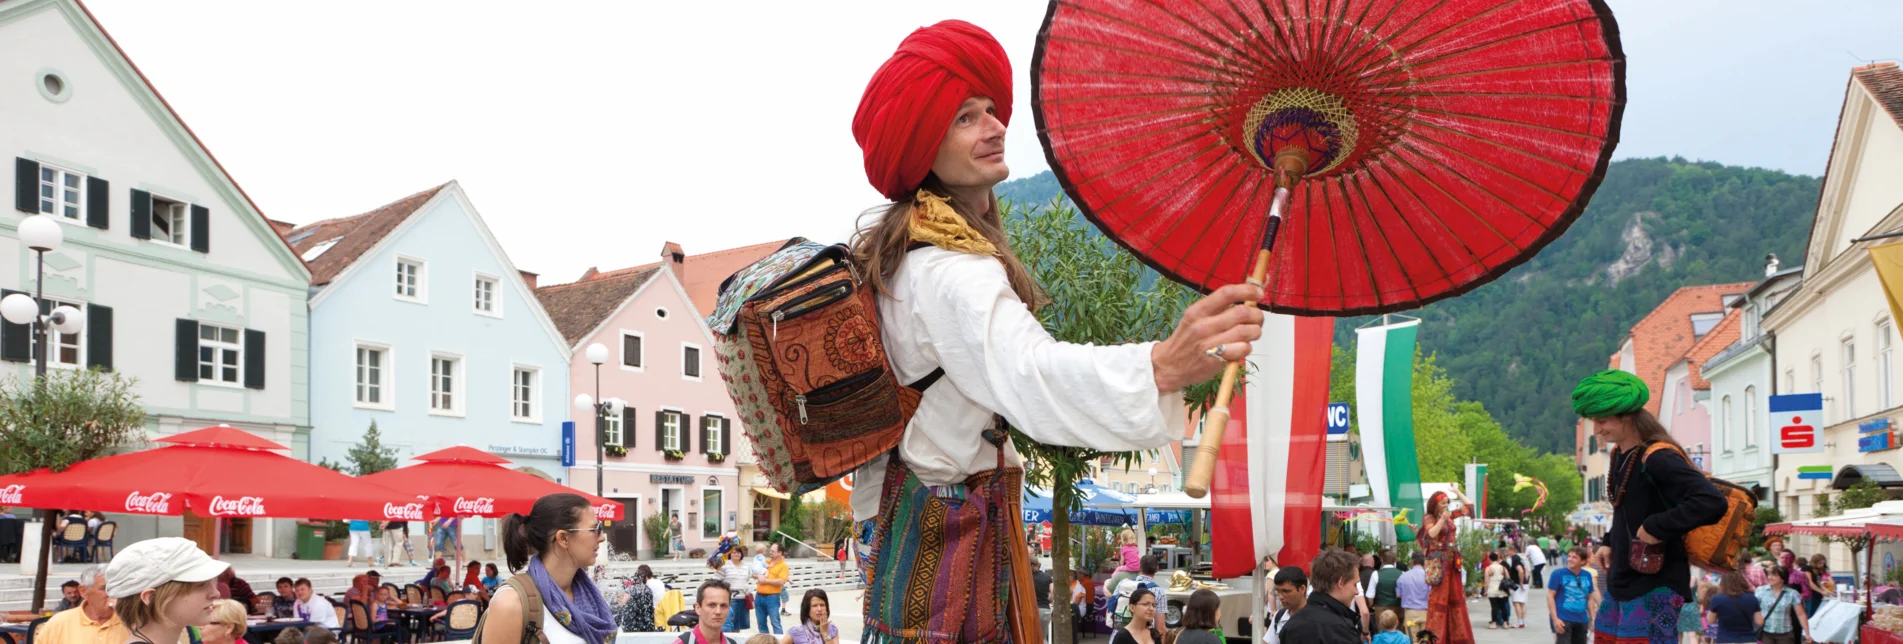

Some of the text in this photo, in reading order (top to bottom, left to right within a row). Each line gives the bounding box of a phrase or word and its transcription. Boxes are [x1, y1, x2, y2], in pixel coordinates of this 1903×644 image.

[209, 495, 267, 516] Coca-Cola
[383, 502, 425, 520] Coca-Cola
[453, 496, 495, 514] Coca-Cola
[1022, 510, 1040, 522] ER
